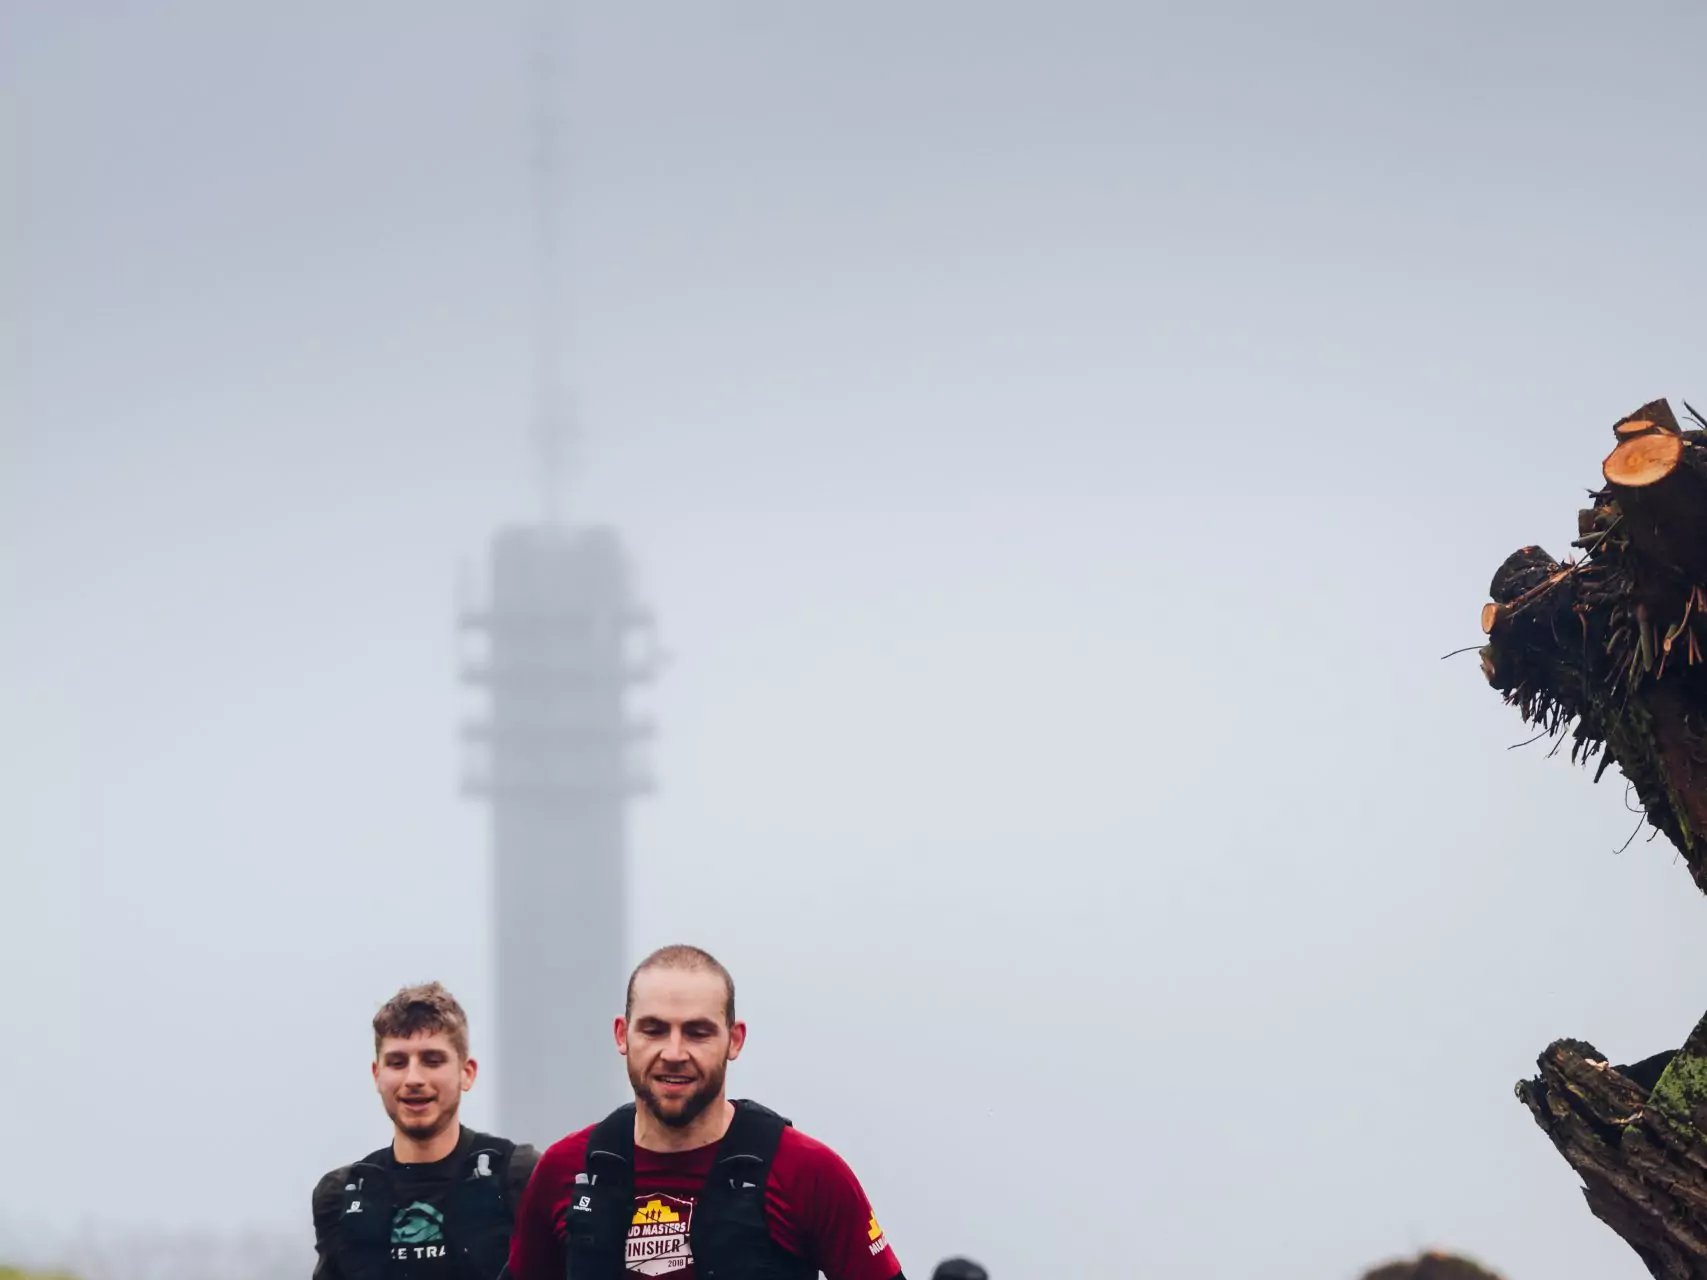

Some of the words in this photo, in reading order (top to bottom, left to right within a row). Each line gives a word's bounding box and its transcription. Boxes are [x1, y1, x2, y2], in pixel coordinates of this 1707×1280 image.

[628, 1226, 640, 1237] UD
[642, 1222, 686, 1236] MASTERS
[628, 1239, 680, 1257] INISHER
[668, 1259, 684, 1268] 2018
